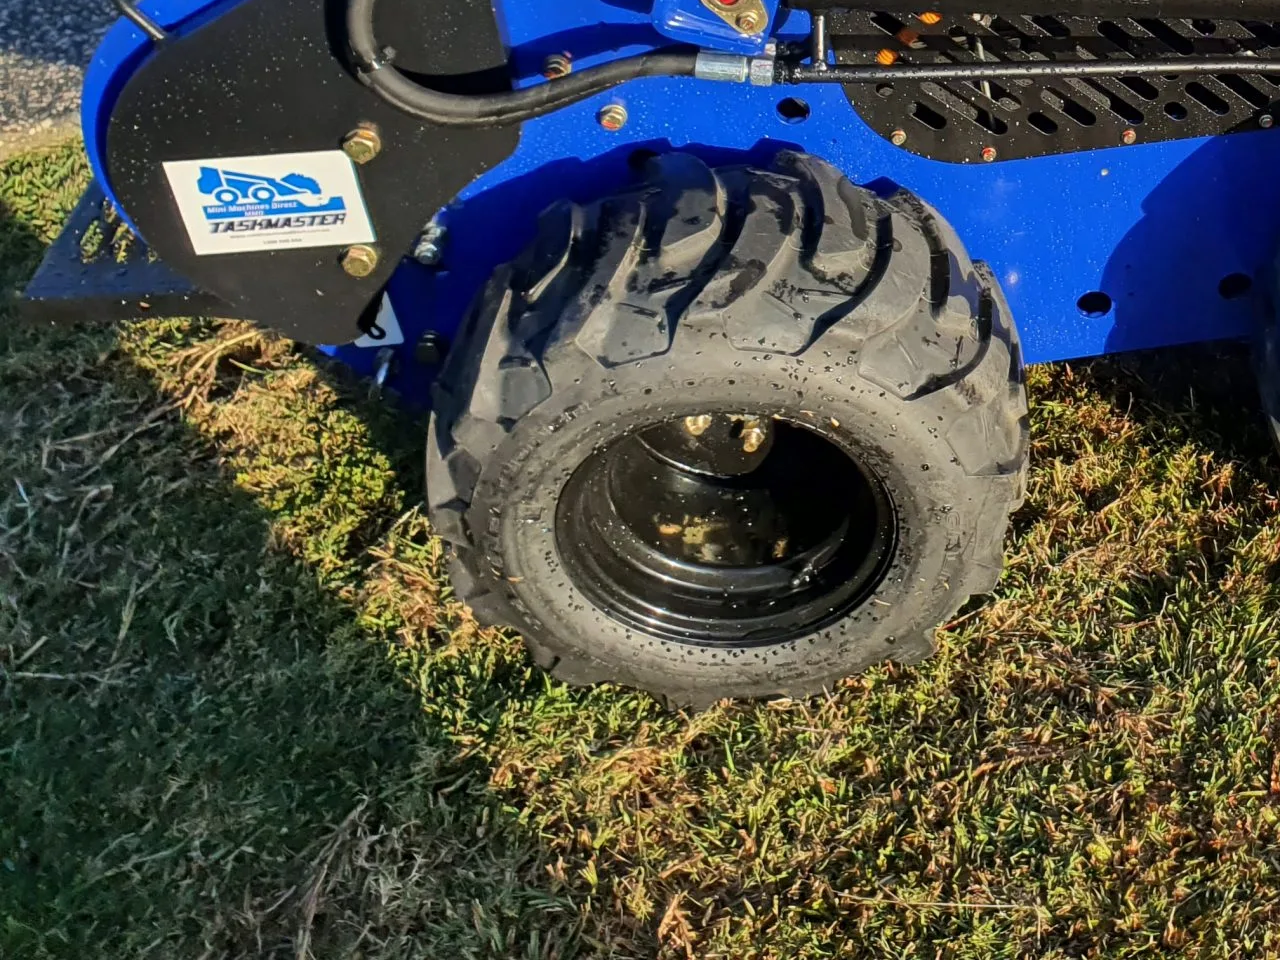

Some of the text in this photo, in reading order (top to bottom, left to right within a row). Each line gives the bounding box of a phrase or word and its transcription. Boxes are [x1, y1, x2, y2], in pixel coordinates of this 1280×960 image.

[207, 205, 227, 213] Mini
[228, 203, 270, 212] Machines
[209, 213, 347, 234] TASKMASTER
